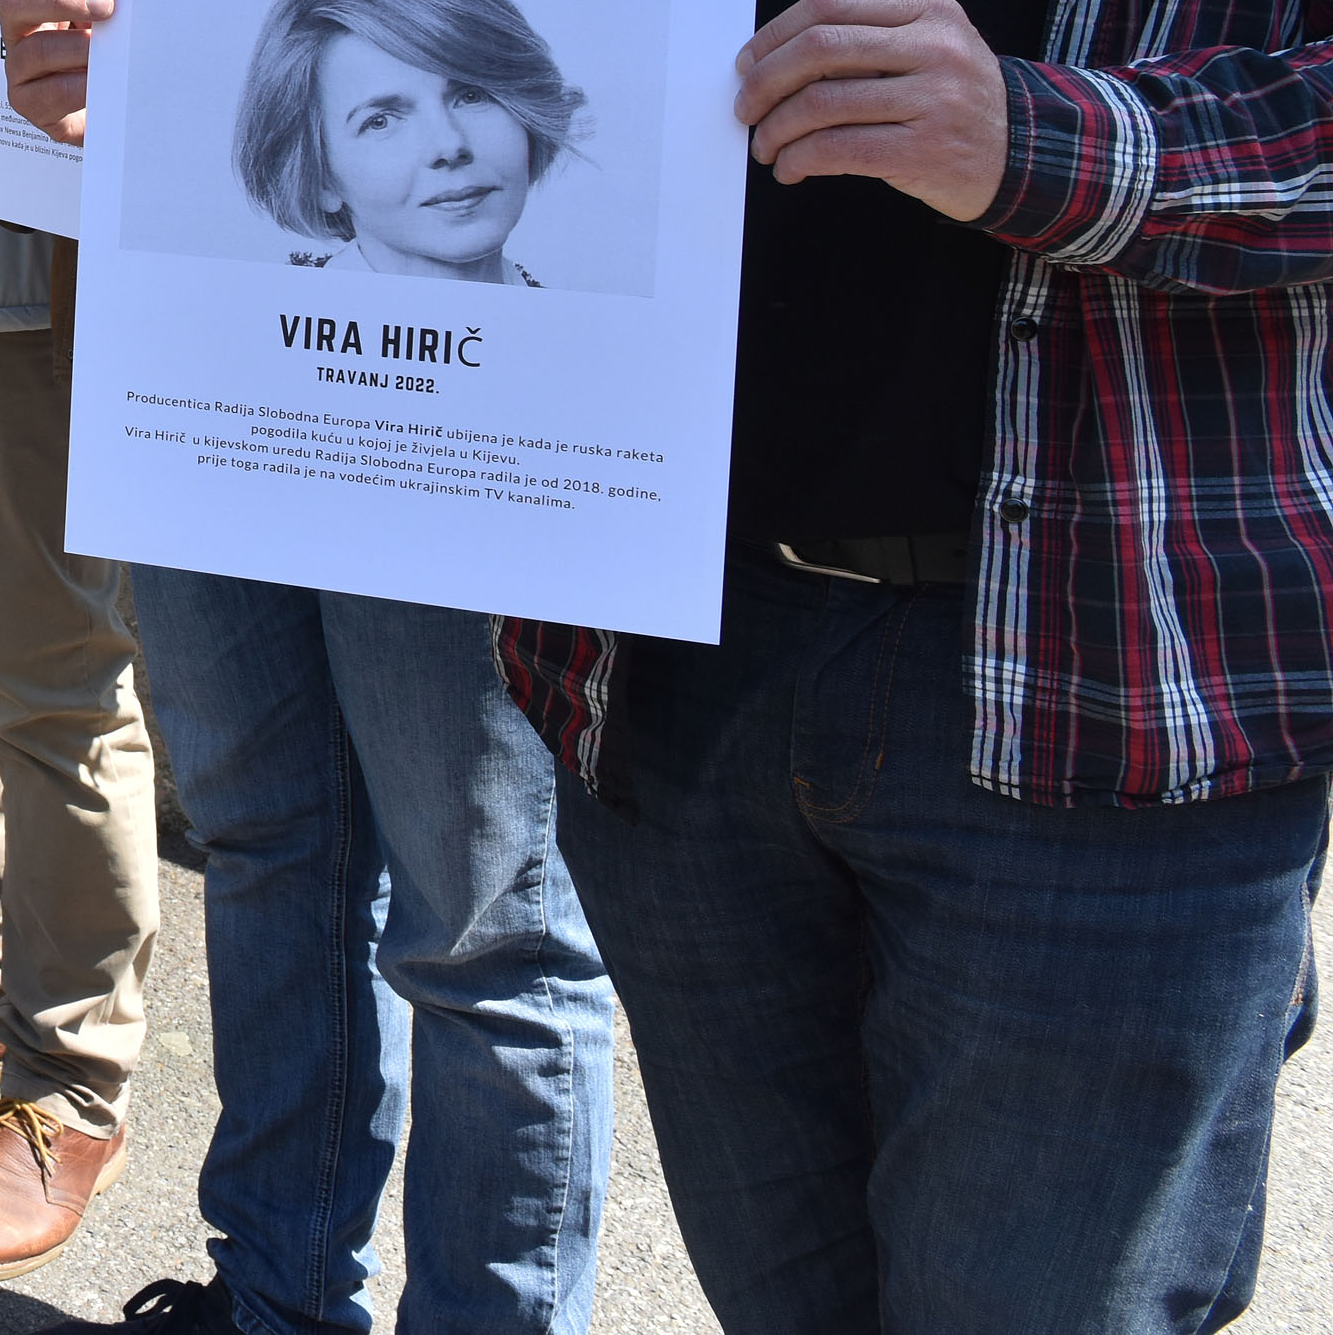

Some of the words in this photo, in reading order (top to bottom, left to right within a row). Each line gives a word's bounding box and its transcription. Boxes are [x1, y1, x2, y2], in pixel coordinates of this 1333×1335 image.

[279, 314, 363, 355] VIRA
[381, 324, 483, 367] HIRIČ
[317, 367, 389, 388] TRAVANJ
[395, 375, 439, 394] 2022.
[127, 391, 210, 411] Producentica
[215, 401, 254, 417] Radija
[258, 406, 319, 423] Slobodna
[323, 413, 370, 430] Europa
[375, 419, 403, 433] Vira
[408, 423, 443, 438] Hirič
[447, 428, 497, 444] ubijena
[501, 434, 514, 447] je
[519, 436, 551, 450] kada
[555, 440, 568, 453] je
[573, 444, 611, 457] ruska
[617, 448, 663, 463] raketa
[251, 426, 307, 440] pogodila
[311, 430, 342, 444] kuću
[347, 437, 354, 446] u
[359, 435, 391, 452] kojoj
[394, 440, 407, 453] je
[411, 442, 455, 458] živjela
[460, 450, 467, 459] u
[473, 449, 520, 465] Kijevu.
[125, 426, 151, 439] Vira
[155, 429, 186, 444] Hirič
[193, 437, 200, 445] u
[204, 435, 269, 453] kijevskom
[273, 447, 311, 459] uredu
[315, 449, 356, 466] Radija
[360, 454, 423, 472] Slobodna
[427, 462, 476, 479] Europa
[481, 471, 520, 484] radila
[524, 474, 537, 487] je
[541, 477, 559, 488] od
[563, 478, 603, 494] 2018.
[608, 487, 661, 502] godine,
[197, 454, 227, 467] prije
[231, 457, 259, 471] toga
[263, 463, 300, 475] radila
[303, 466, 316, 478] je
[320, 470, 335, 480] na
[339, 473, 395, 487] vodećim
[400, 478, 480, 498] ukrajinskim
[484, 488, 504, 500] TV
[508, 490, 575, 509] kanalima.
